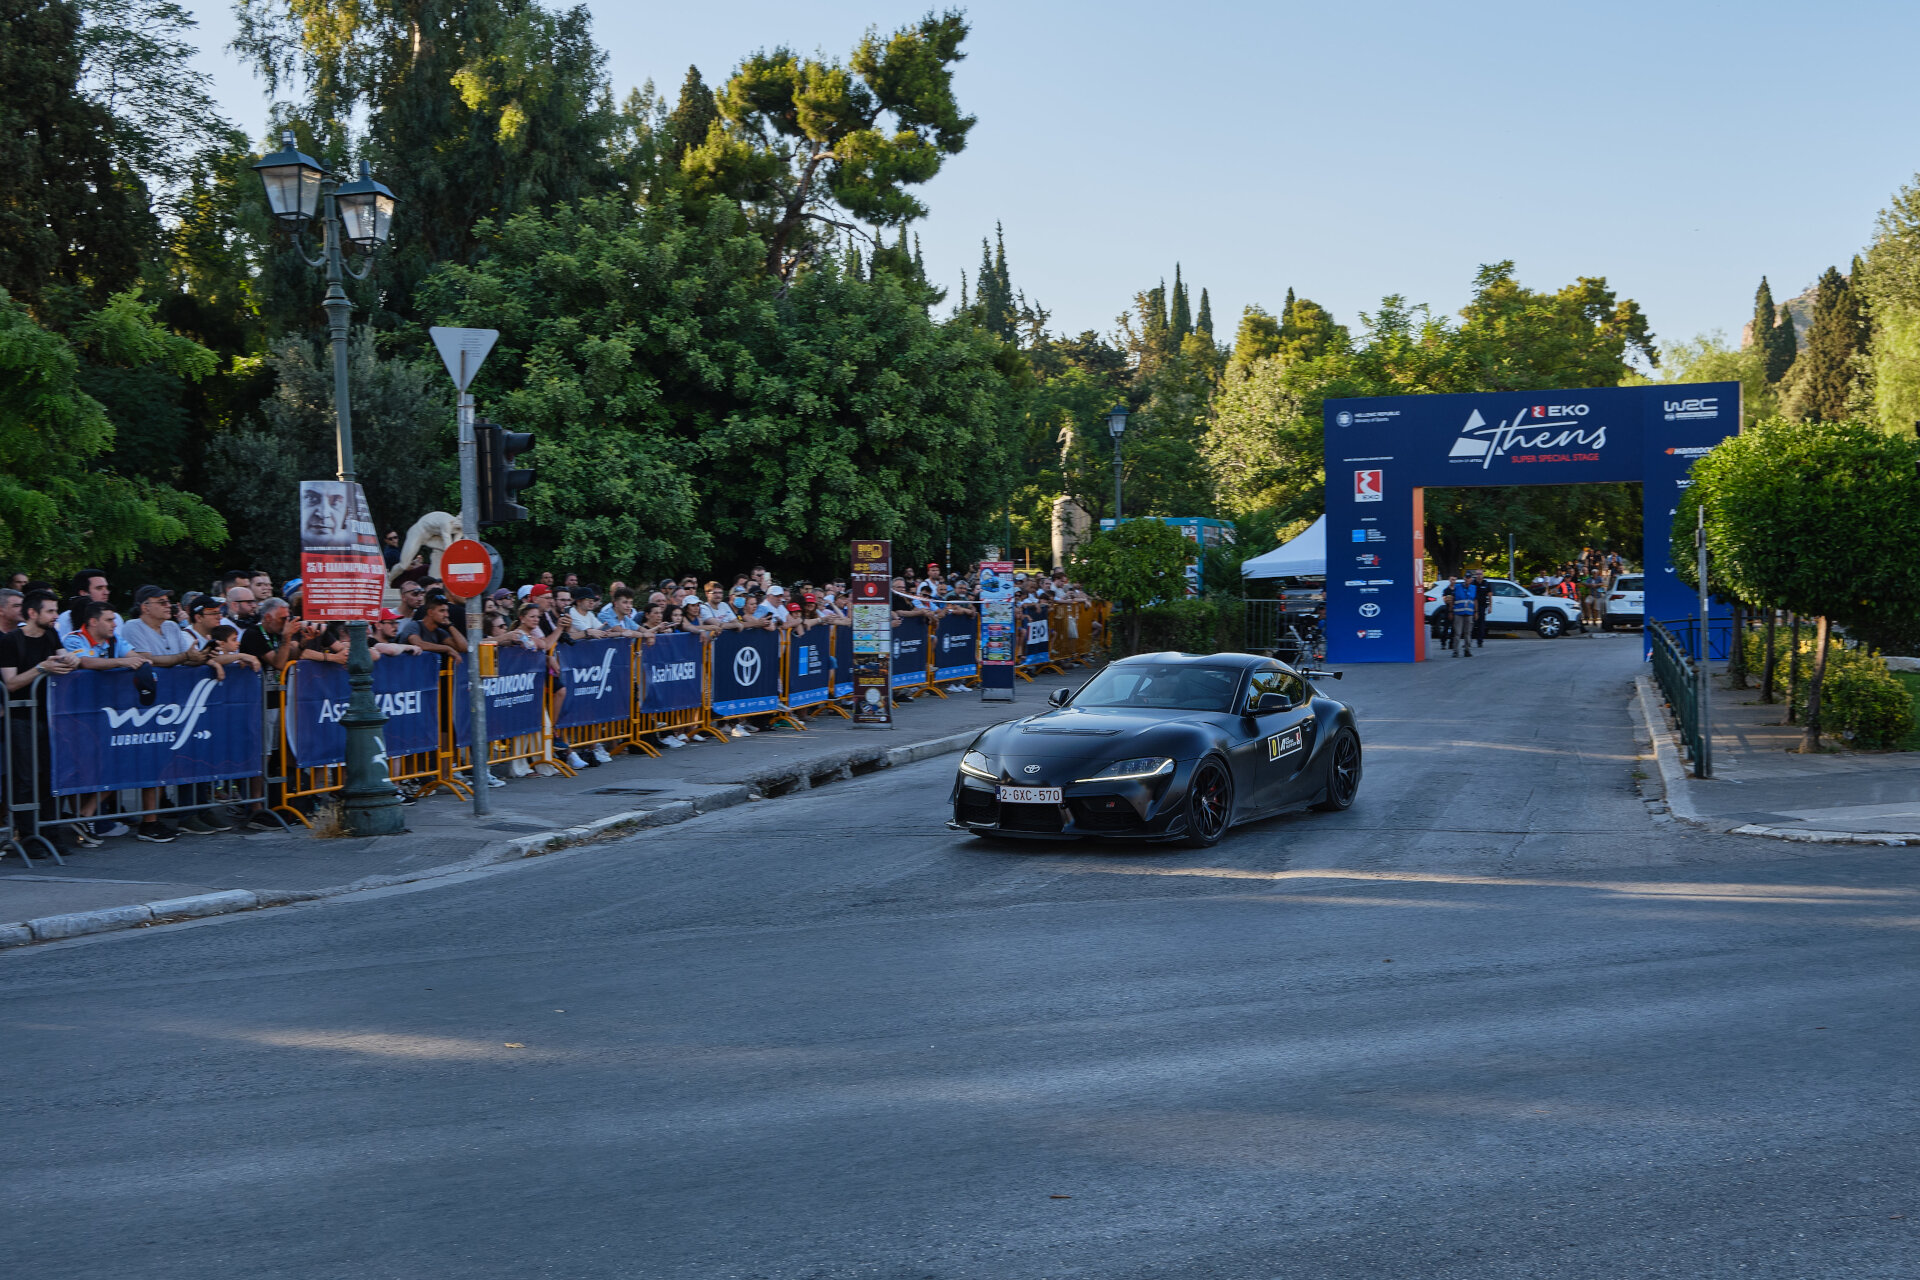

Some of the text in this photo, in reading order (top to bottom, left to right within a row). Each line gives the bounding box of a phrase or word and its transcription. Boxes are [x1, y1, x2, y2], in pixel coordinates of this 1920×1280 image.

[1548, 404, 1590, 417] EKO
[1664, 398, 1718, 412] WRC
[1511, 453, 1600, 463] SUPER SPECIAL STAGE
[110, 731, 177, 747] LUBRICANTS
[1001, 788, 1060, 801] 2-GXC-570
